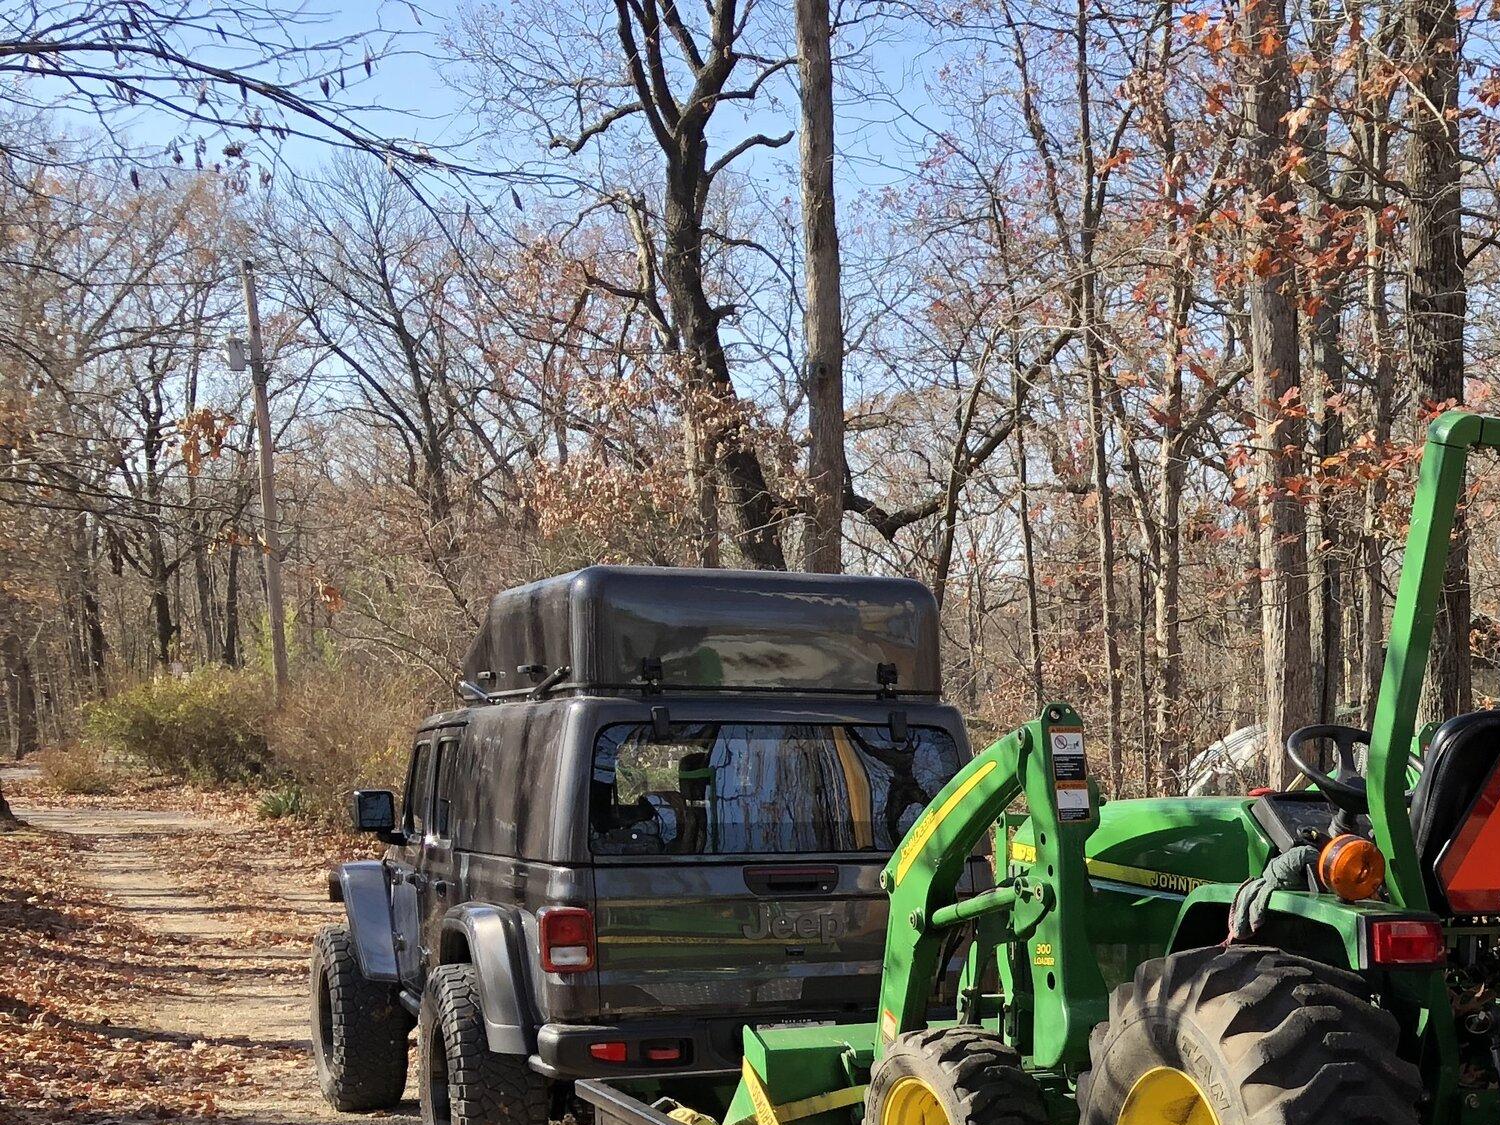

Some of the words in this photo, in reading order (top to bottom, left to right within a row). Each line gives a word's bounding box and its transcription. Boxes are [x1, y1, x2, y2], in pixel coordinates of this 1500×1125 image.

[1152, 873, 1187, 891] JOHN
[741, 903, 848, 944] Jeep
[1036, 943, 1051, 954] 300
[1033, 957, 1055, 966] LOADER
